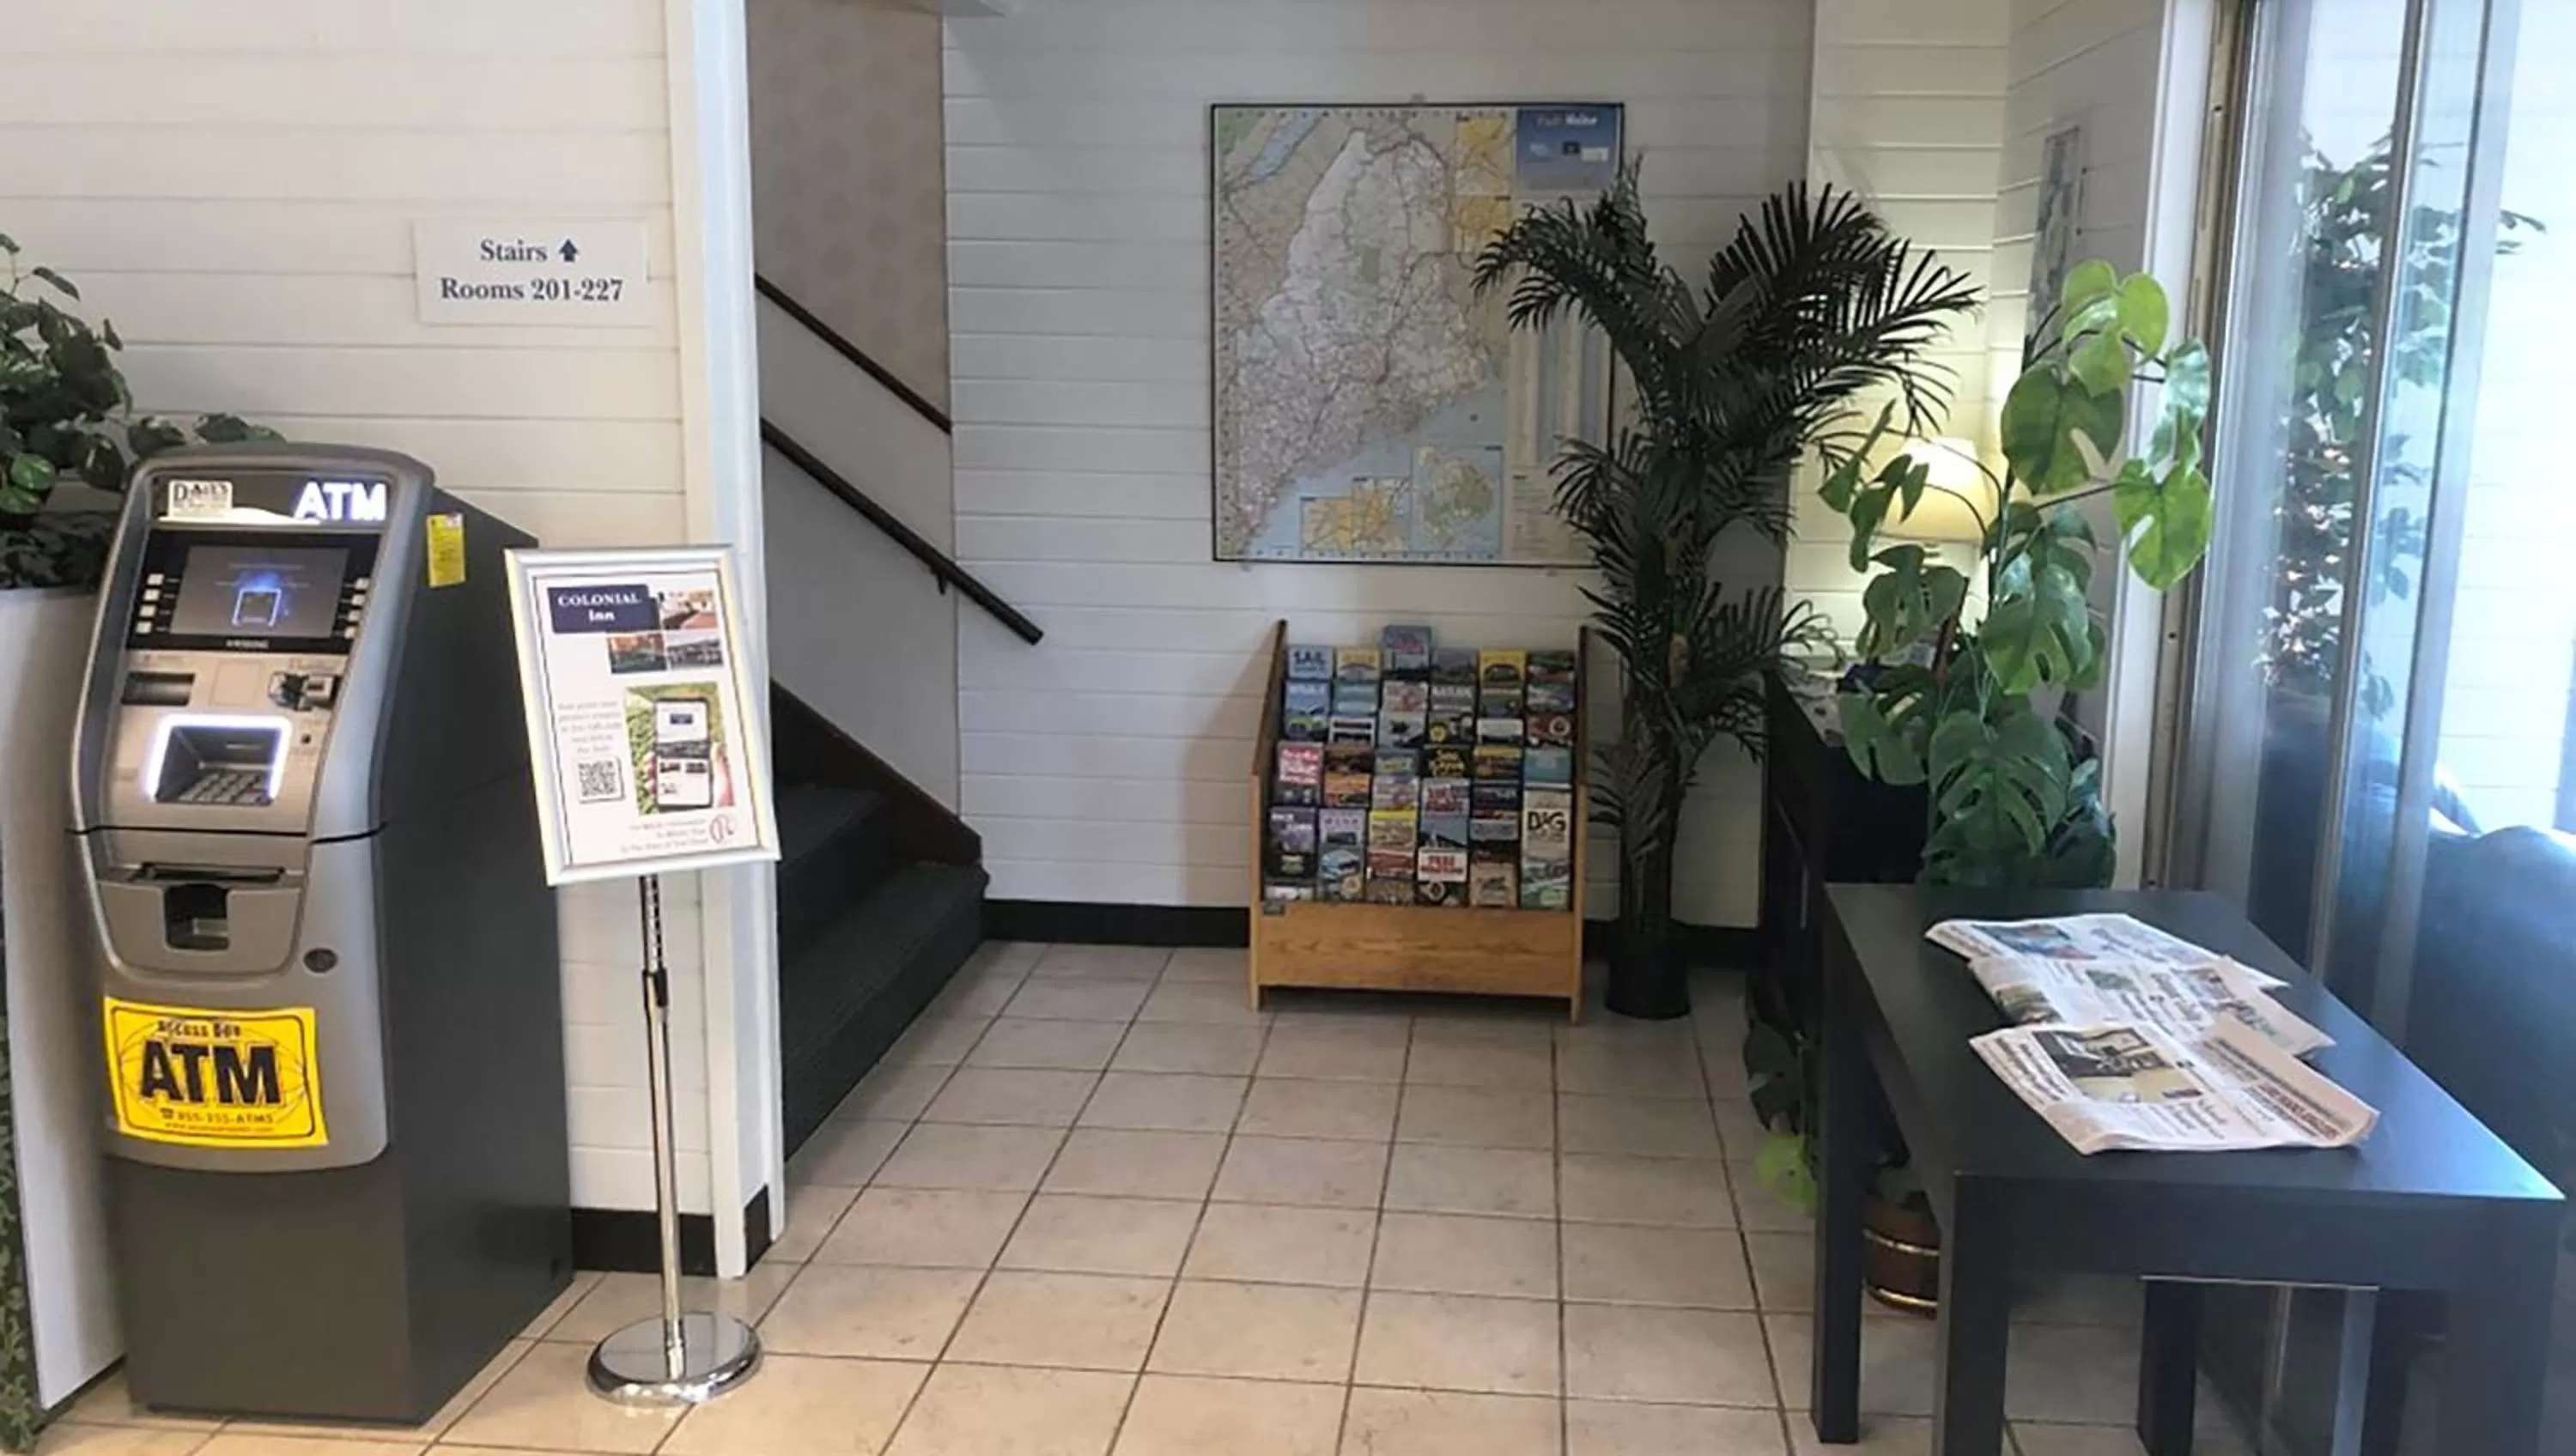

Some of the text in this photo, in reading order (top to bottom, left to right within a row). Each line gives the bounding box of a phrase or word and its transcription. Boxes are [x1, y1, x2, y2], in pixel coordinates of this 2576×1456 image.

[480, 238, 549, 262] Stairs
[440, 277, 623, 301] Rooms 201-227
[294, 481, 387, 521] ATM
[557, 592, 642, 608] COLONIAL
[588, 608, 616, 622] Inn
[141, 1040, 282, 1105] ATM
